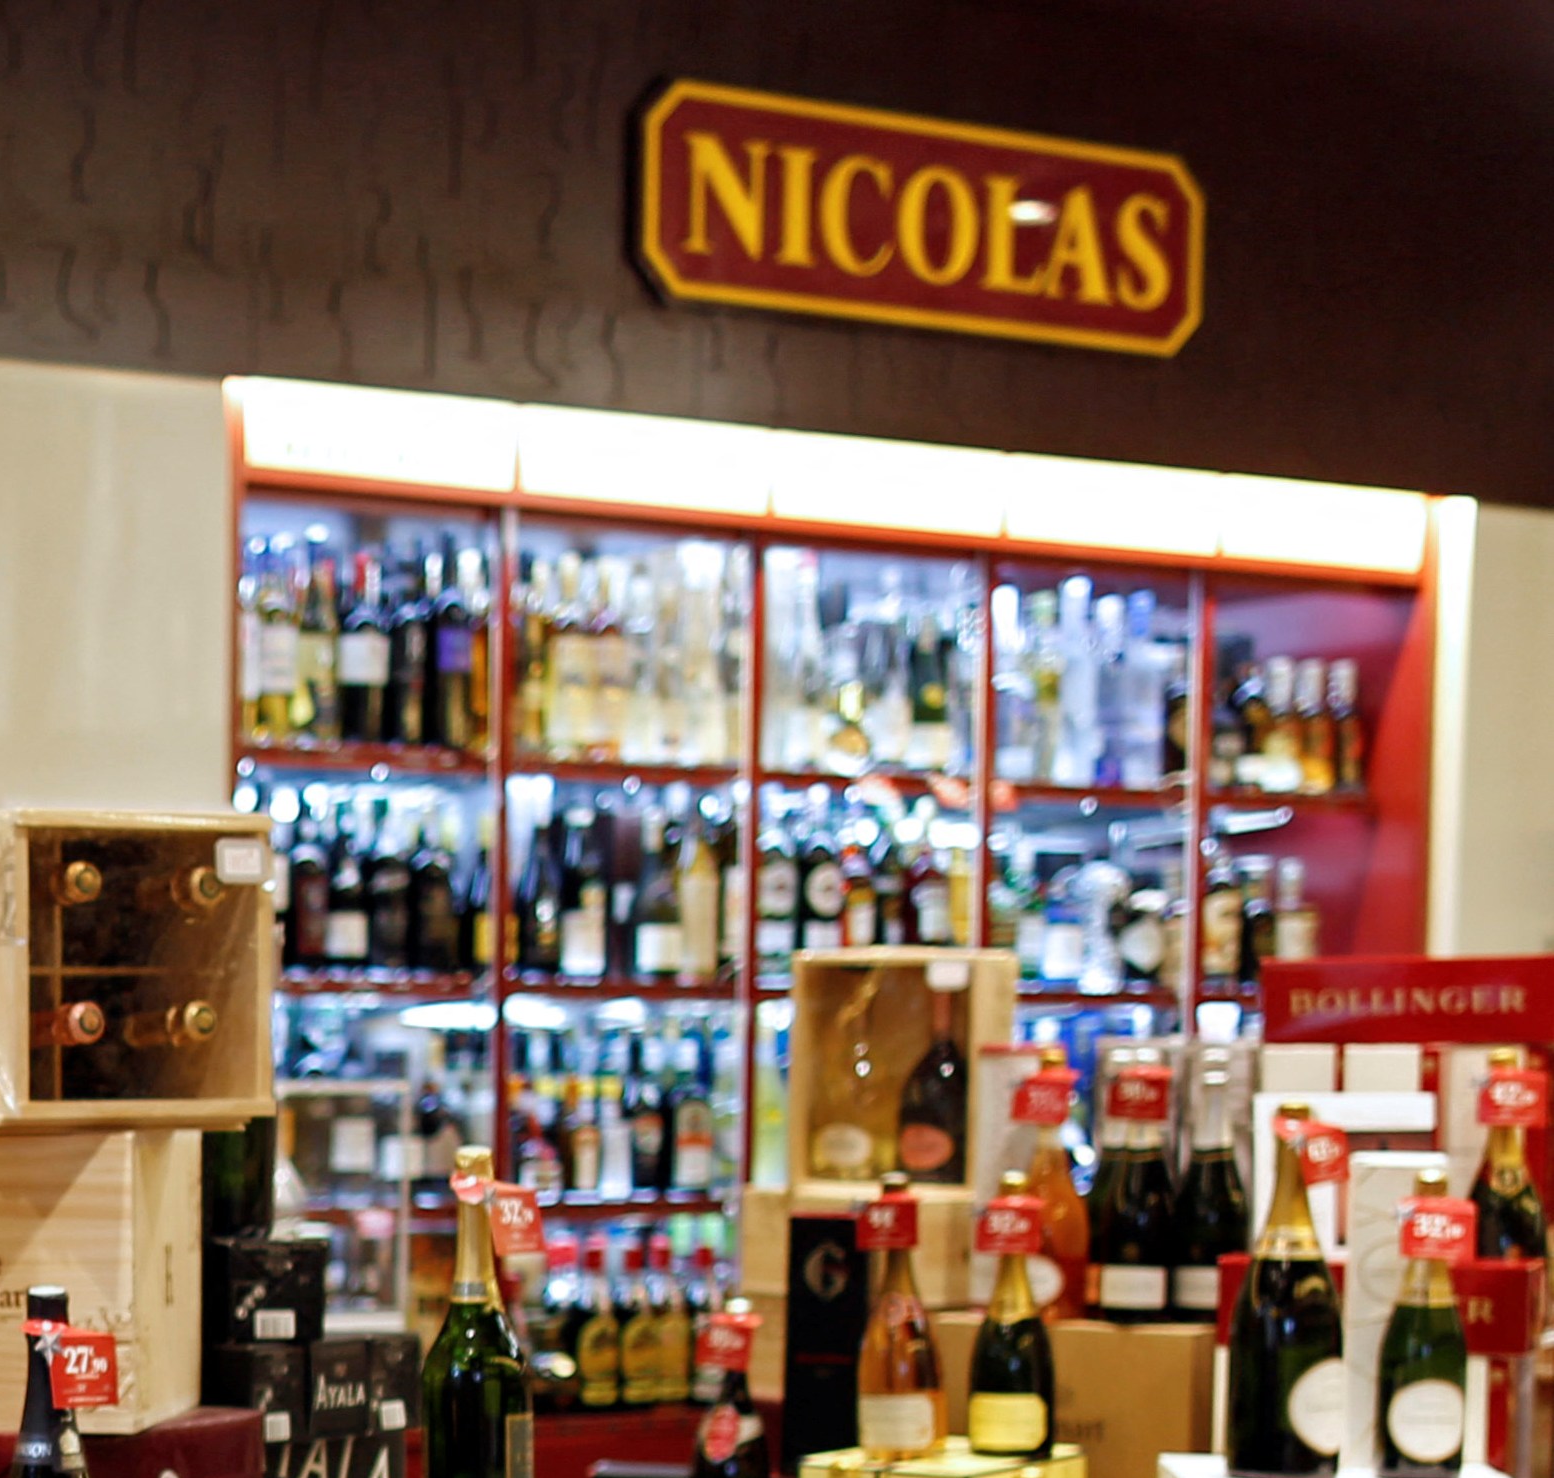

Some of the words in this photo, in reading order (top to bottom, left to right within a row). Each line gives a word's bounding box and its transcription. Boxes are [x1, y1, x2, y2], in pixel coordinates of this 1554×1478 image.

[683, 130, 1172, 312] NICOLAS
[1288, 985, 1528, 1017] BOLLINGER
[314, 1374, 367, 1411] AYALA
